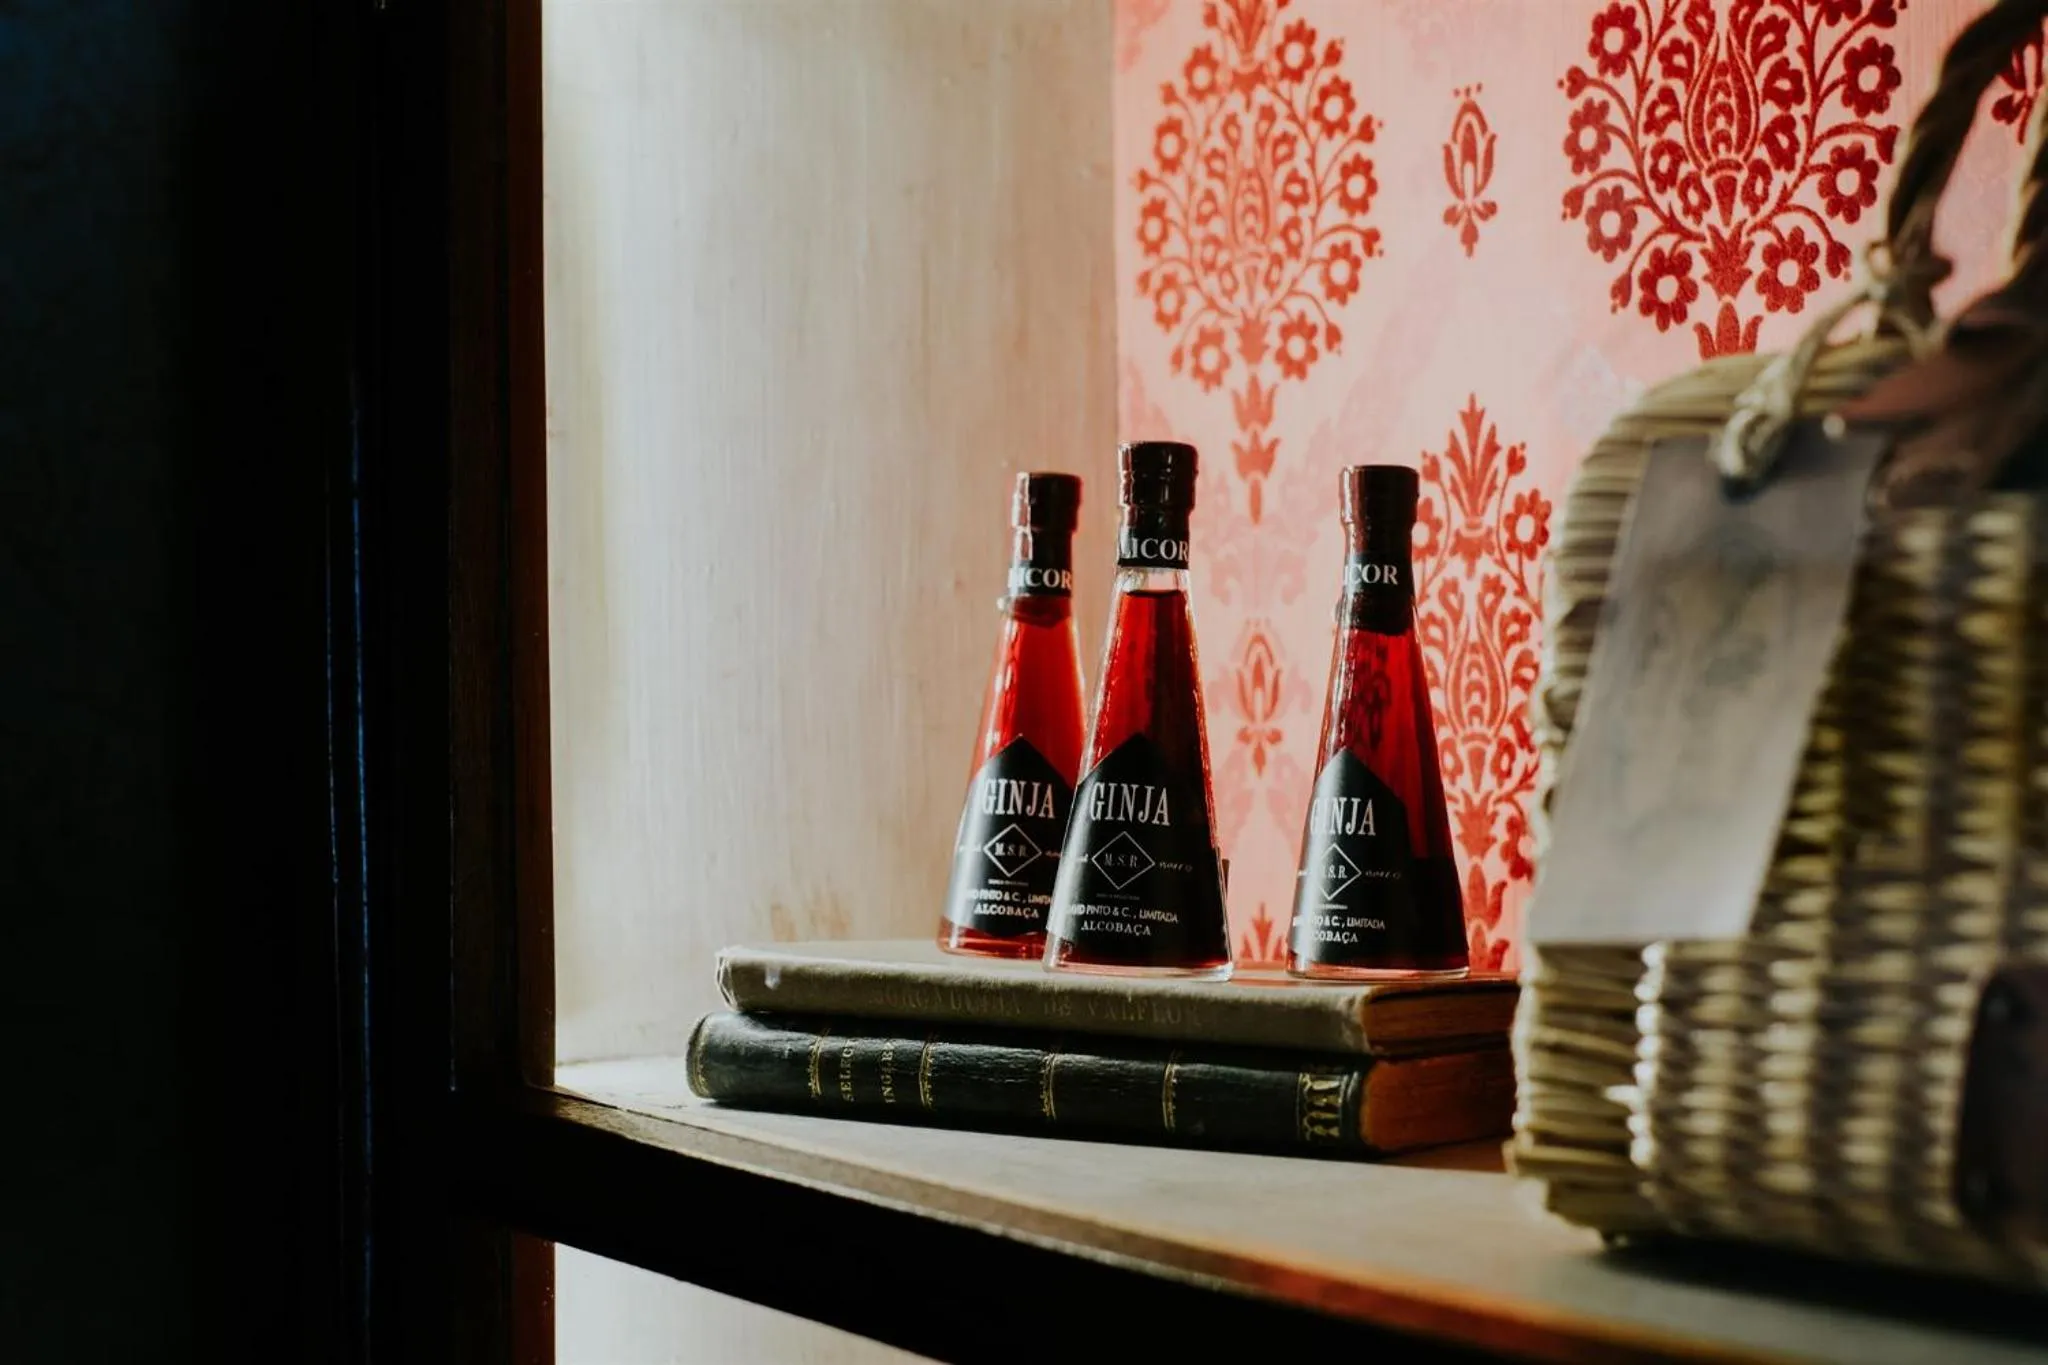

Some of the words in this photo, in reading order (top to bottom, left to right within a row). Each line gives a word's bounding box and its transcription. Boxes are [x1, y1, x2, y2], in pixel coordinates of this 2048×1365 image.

[1120, 538, 1189, 561] LICOR
[983, 778, 1055, 819] GINJA
[1090, 782, 1170, 826] GINJA
[974, 903, 1039, 920] ALCOBAÇA
[1112, 906, 1119, 917] &
[1139, 908, 1179, 924] LIMITADA
[1081, 920, 1151, 937] ALCOBAÇA
[1347, 916, 1386, 931] LIMITADA
